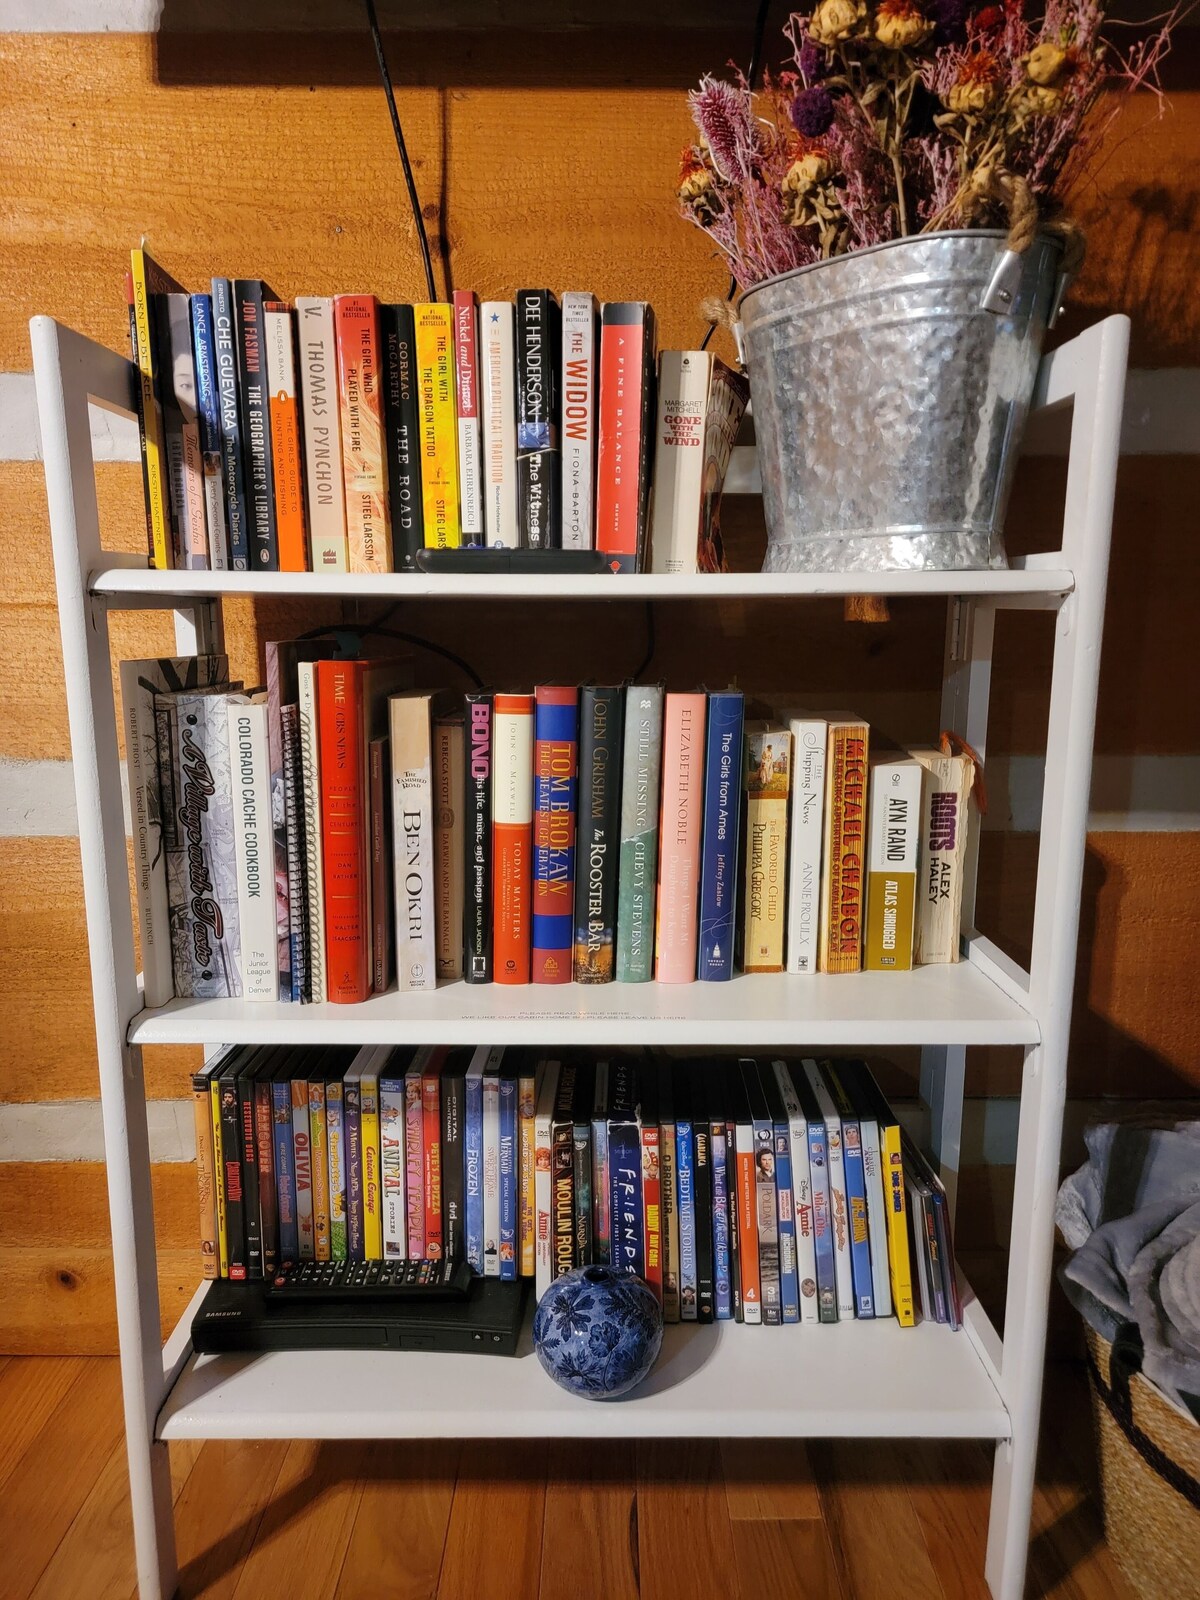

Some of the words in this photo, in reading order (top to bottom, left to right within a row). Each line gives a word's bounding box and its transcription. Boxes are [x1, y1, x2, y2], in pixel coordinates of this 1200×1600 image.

[217, 283, 225, 313] ERNESTO
[243, 300, 256, 322] JON
[525, 297, 540, 321] DEE
[196, 303, 205, 333] LANCE
[217, 316, 230, 349] CHE
[361, 328, 370, 346] THE
[459, 306, 470, 342] Nickel
[245, 328, 259, 372] FASMAN
[363, 350, 371, 369] GIRL
[437, 336, 446, 354] THE
[461, 346, 470, 366] and
[572, 332, 582, 353] THE
[198, 339, 210, 397] ARMSTRONG
[277, 358, 285, 381] BANK
[307, 341, 327, 416] THOMAS
[364, 372, 373, 393] WHO
[399, 342, 409, 400] CORMAC
[424, 367, 432, 384] THE
[439, 357, 447, 376] GIRL
[489, 341, 501, 387] AMERICAN
[526, 327, 542, 416] HENDERSON
[220, 354, 236, 430] GUEVARA
[248, 386, 262, 405] THE
[348, 369, 358, 402] PLAYED
[439, 379, 448, 402] WITH
[565, 359, 588, 441] WIDOW
[350, 404, 359, 428] WITH
[425, 387, 433, 423] DRAGON
[491, 390, 503, 433] POLITICAL
[664, 416, 701, 425] GONE
[665, 406, 700, 414] MITCHELL
[226, 435, 235, 453] The
[249, 410, 266, 490] GEOGRAPHER'S
[351, 431, 361, 452] FIRE
[397, 425, 409, 464] THE
[426, 425, 435, 457] TATTOO
[464, 424, 473, 465] BARBARA
[663, 437, 700, 447] WIND
[313, 427, 333, 505] PYNCHON
[492, 439, 504, 483] TRADITION
[530, 454, 541, 480] The
[210, 480, 219, 497] Every
[226, 455, 239, 509] Motorcycle
[279, 477, 287, 516] FISHING
[466, 467, 475, 526] EHRENREICH
[211, 499, 220, 525] Second
[255, 495, 269, 540] LIBRARY
[362, 495, 372, 519] STIEG
[399, 475, 412, 529] ROAD
[530, 484, 541, 541] Witness
[572, 492, 580, 541] BARTON
[213, 527, 221, 553] Counts
[232, 512, 241, 545] Diaries
[363, 523, 374, 561] LARSSON
[334, 673, 345, 704] TIME
[336, 712, 346, 733] CBS
[592, 698, 610, 739] JOHN
[182, 729, 202, 760] A
[237, 717, 253, 784] COLORADO
[336, 737, 347, 768] NEWS
[441, 736, 449, 774] REBECCA
[472, 703, 489, 779] BONO
[540, 744, 550, 769] THE
[639, 720, 649, 761] STILL
[678, 710, 691, 792] ELIZABETH
[722, 733, 732, 752] The
[550, 744, 571, 792] TOM
[720, 755, 731, 778] Girls
[801, 732, 825, 789] Shipping
[135, 786, 146, 813] Versed
[475, 775, 485, 789] His
[539, 771, 550, 824] GREATEST
[592, 747, 608, 818] GRISHAM
[636, 767, 648, 827] MISSING
[719, 781, 729, 806] from
[843, 738, 865, 847] MICHAEL
[138, 816, 147, 824] in
[179, 765, 215, 842] Village
[241, 790, 256, 828] CACHE
[676, 798, 688, 845] NOBLE
[802, 792, 817, 824] News
[889, 798, 908, 822] AYN
[929, 792, 957, 851] ROOTS
[137, 827, 150, 860] Country
[403, 810, 421, 867] BEN
[593, 829, 604, 841] The
[718, 809, 728, 840] Ames
[442, 834, 450, 867] DARWIN
[476, 845, 485, 862] and
[513, 841, 521, 880] TODAY
[538, 828, 549, 896] GENERATION
[549, 801, 570, 896] BROKAW
[752, 822, 767, 870] PHILIPPA
[887, 829, 906, 861] RAND
[140, 863, 151, 890] Things
[189, 843, 212, 893] with
[245, 832, 261, 898] COOKBOOK
[474, 865, 485, 903] passions
[589, 843, 606, 916] ROOSTER
[634, 842, 645, 889] CHEVY
[715, 854, 725, 880] Jeffrey
[801, 862, 812, 899] ANNIE
[928, 857, 939, 905] HALEY
[939, 862, 951, 899] ALEX
[405, 872, 423, 940] OKRI
[716, 881, 724, 907] Zaslow
[751, 872, 765, 920] GREGORY
[840, 853, 861, 954] CHABON
[884, 880, 898, 905] ATLAS
[145, 908, 153, 945] BULFINCH
[442, 910, 450, 953] BARNACLE
[513, 886, 521, 939] MATTERS
[631, 894, 643, 955] STEVENS
[800, 902, 812, 945] PROULX
[883, 908, 897, 949] SHRUGGED
[192, 898, 223, 966] Taste
[588, 921, 603, 953] BAR
[243, 1102, 253, 1140] RESERVOIR
[257, 1105, 271, 1172] HANGOVER
[245, 1144, 254, 1162] DOGS
[295, 1133, 310, 1191] OLIVIA
[330, 1131, 342, 1192] Charlotte's
[365, 1146, 375, 1181] Curious
[407, 1117, 421, 1177] SHIRLEY
[696, 1133, 706, 1166] CASABLANCA
[866, 1147, 877, 1176] chasing
[383, 1135, 400, 1198] ANIMAL
[467, 1149, 478, 1196] FROZEN
[332, 1193, 343, 1218] Web
[366, 1182, 377, 1215] George
[409, 1184, 422, 1242] TEMPLE
[556, 1179, 573, 1232] MOULIN
[679, 1169, 690, 1221] BEDTIME
[761, 1188, 773, 1232] POLDARK
[538, 1210, 550, 1240] Annie
[577, 1215, 587, 1248] NARNIA
[646, 1205, 659, 1232] DADDY
[648, 1249, 659, 1267] CARE
[649, 1235, 659, 1248] DAY
[682, 1225, 693, 1269] STORIES
[781, 1233, 792, 1273] ANCHORMAN
